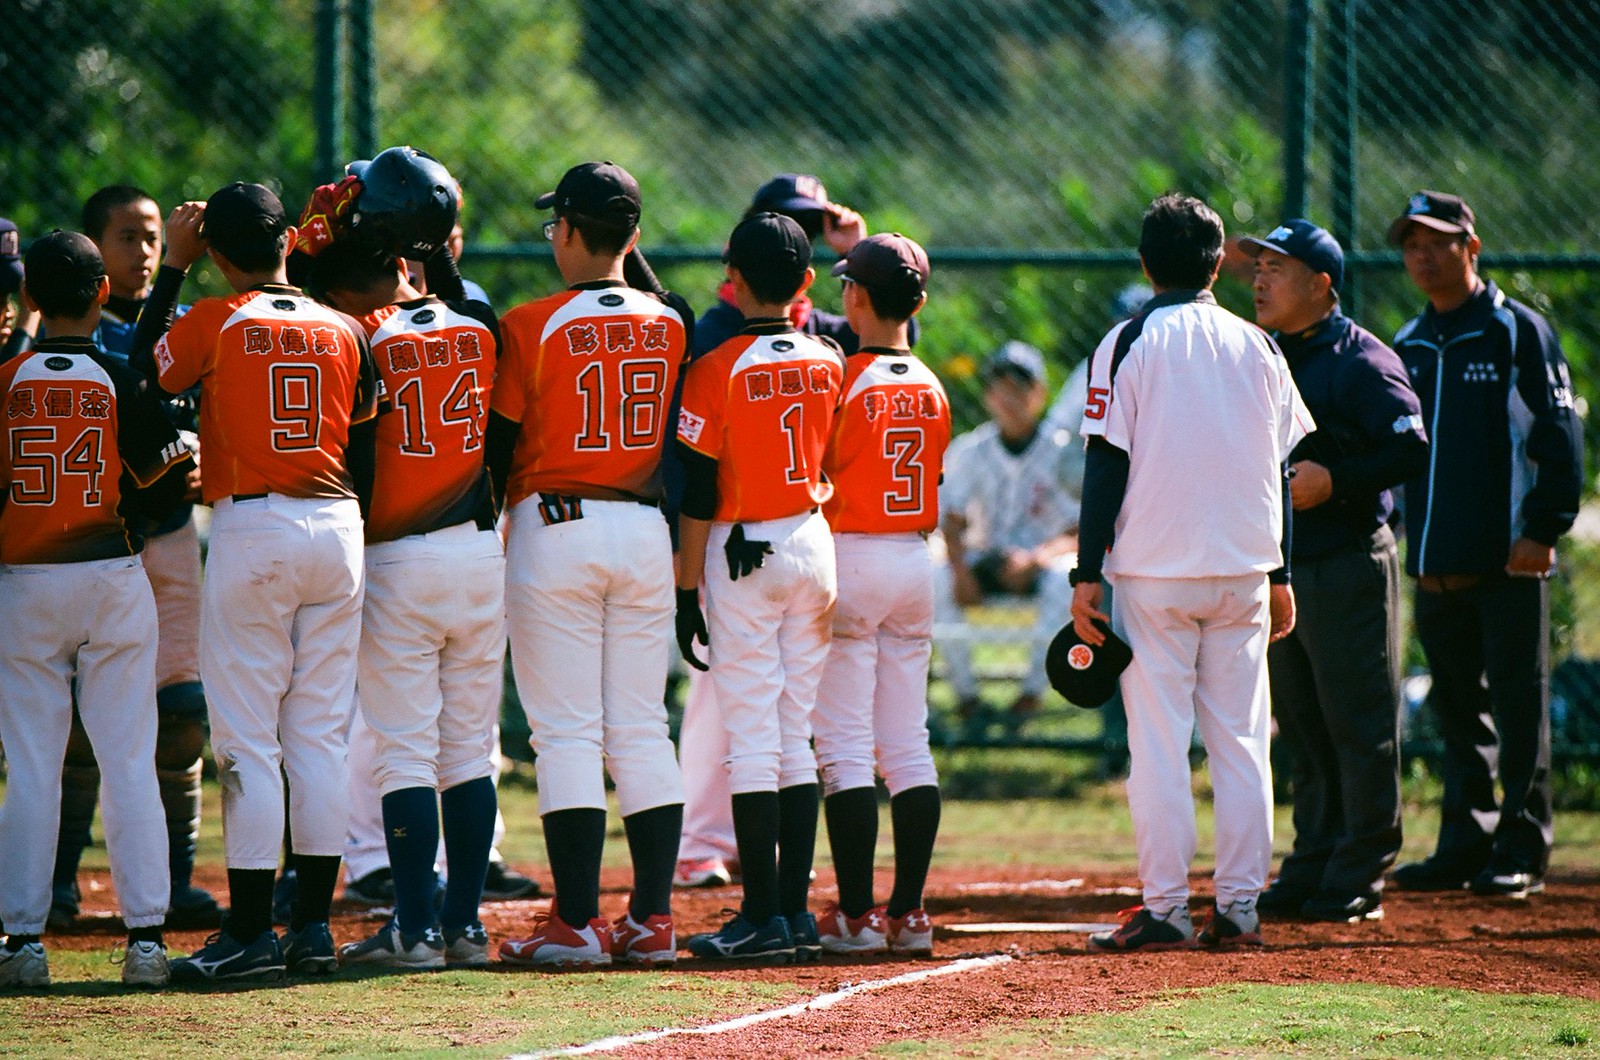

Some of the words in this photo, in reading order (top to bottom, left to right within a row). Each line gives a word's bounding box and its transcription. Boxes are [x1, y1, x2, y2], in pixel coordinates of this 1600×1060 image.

[243, 325, 340, 356] 邱偉亮
[269, 362, 322, 453] 9
[395, 368, 484, 456] 14
[574, 358, 668, 452] 18
[780, 403, 809, 485] 1
[1084, 387, 1109, 420] 5
[9, 426, 105, 507] 54
[883, 427, 924, 516] 3
